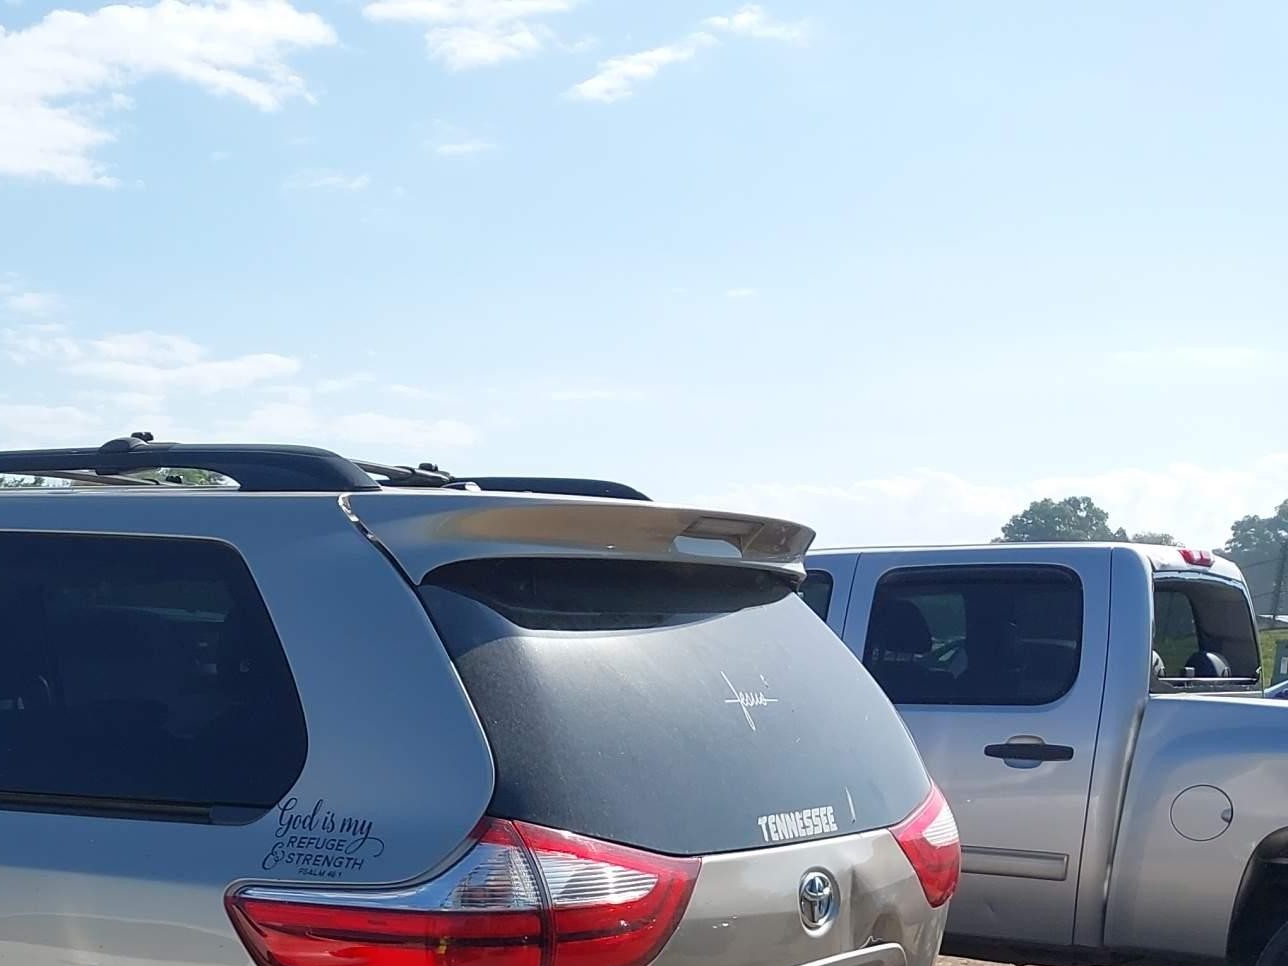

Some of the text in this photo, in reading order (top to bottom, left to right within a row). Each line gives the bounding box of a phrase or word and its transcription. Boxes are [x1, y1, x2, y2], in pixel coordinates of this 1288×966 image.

[275, 797, 385, 858] God is my
[758, 806, 838, 841] TENNESSEE
[262, 841, 364, 870] & STRENGTH
[286, 835, 347, 851] REFUGE
